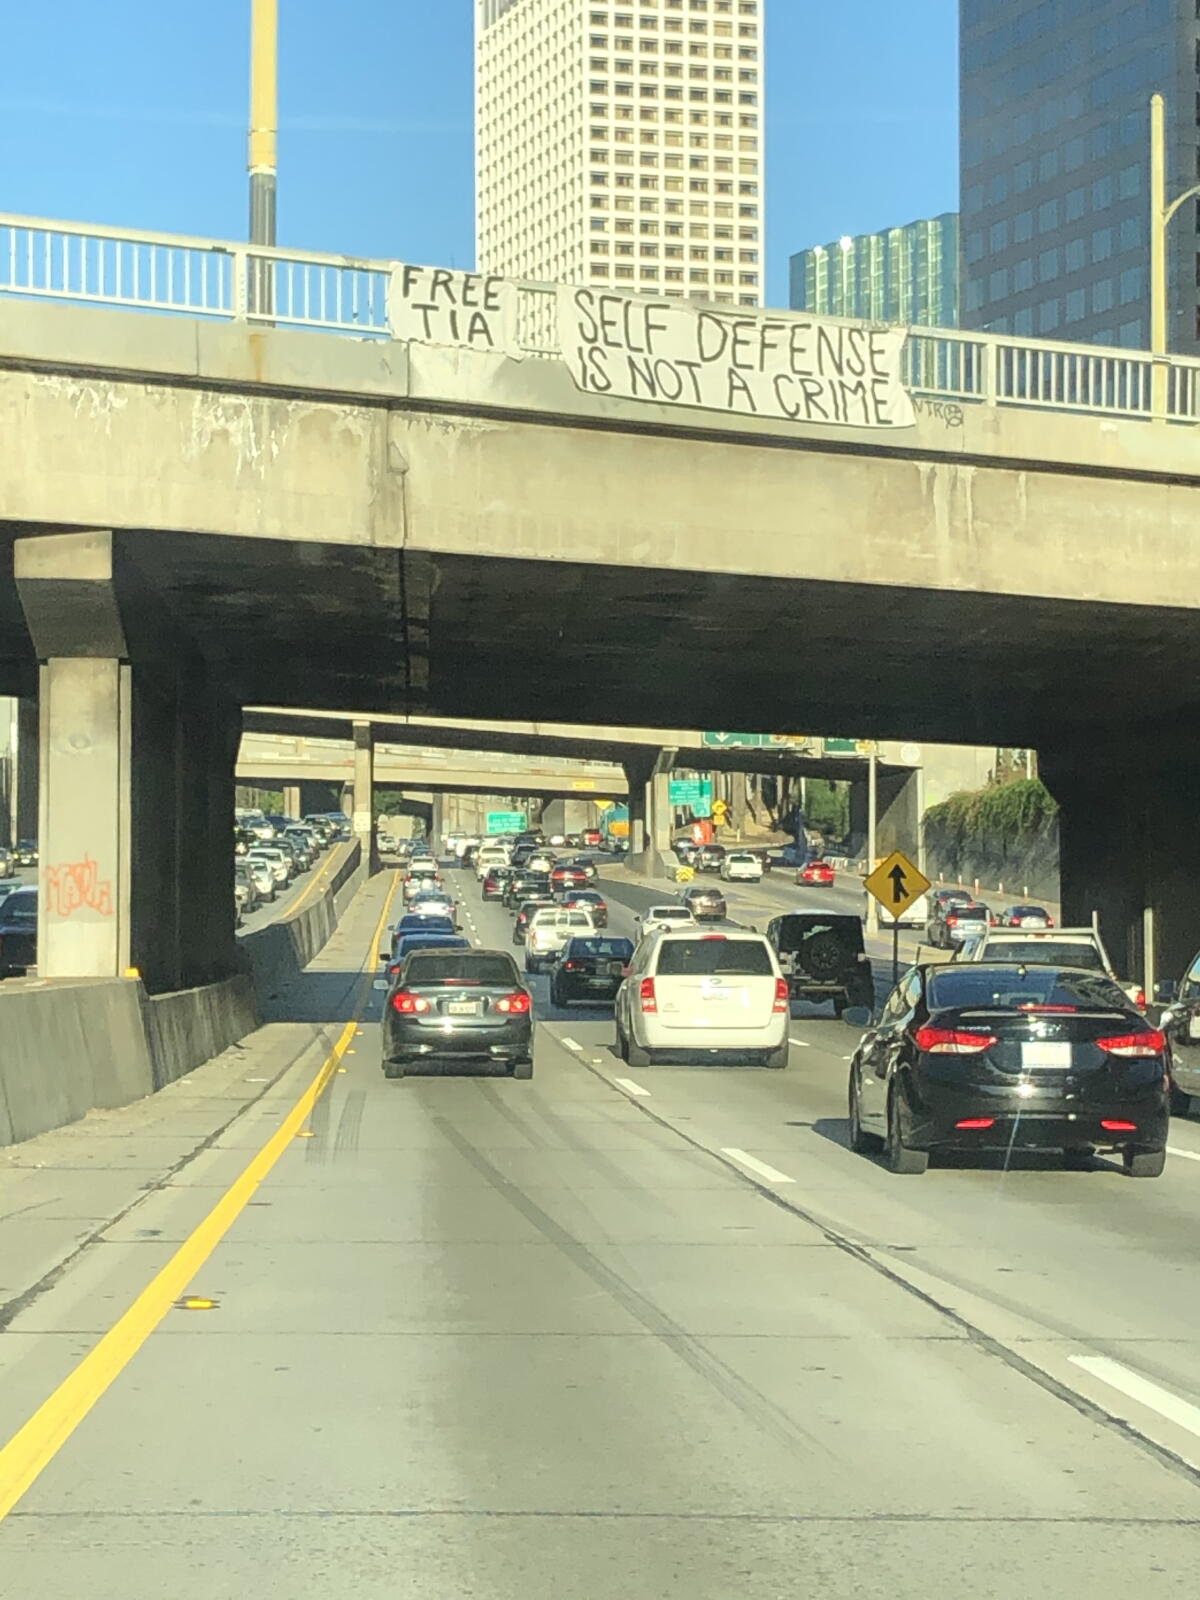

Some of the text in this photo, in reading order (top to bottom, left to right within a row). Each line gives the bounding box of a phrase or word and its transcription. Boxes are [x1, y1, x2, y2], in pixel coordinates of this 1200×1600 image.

[403, 265, 504, 311] FREE
[411, 303, 494, 347] TIA
[574, 289, 890, 377] SELF DEFENSE
[577, 346, 893, 425] IS NOT A CRIME
